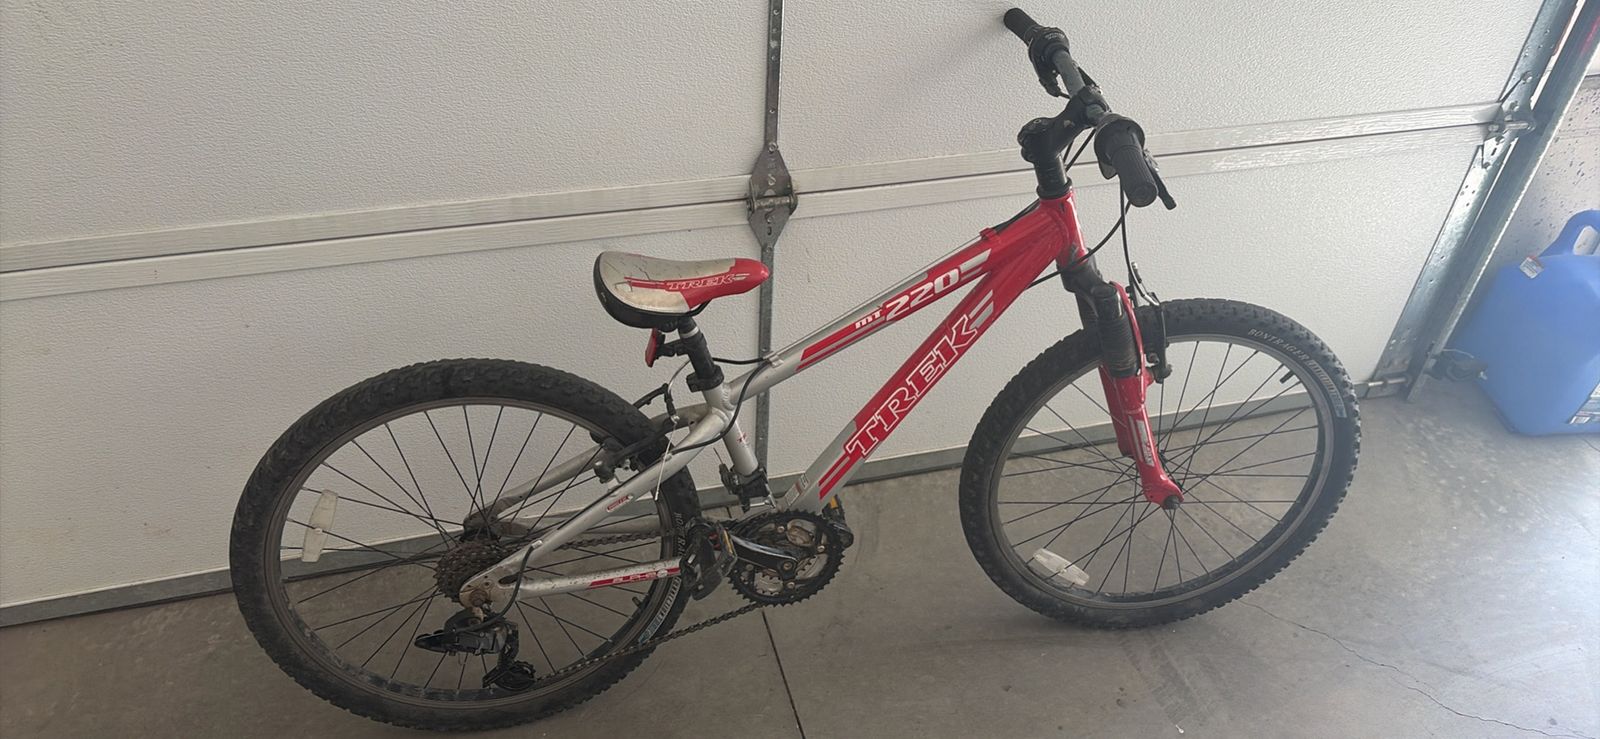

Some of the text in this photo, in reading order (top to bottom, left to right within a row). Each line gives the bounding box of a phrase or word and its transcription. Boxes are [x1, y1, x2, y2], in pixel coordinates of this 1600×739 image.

[666, 274, 734, 290] TREK
[884, 268, 960, 322] 220
[1247, 328, 1311, 361] BONTRAGER
[845, 314, 979, 457] TREK
